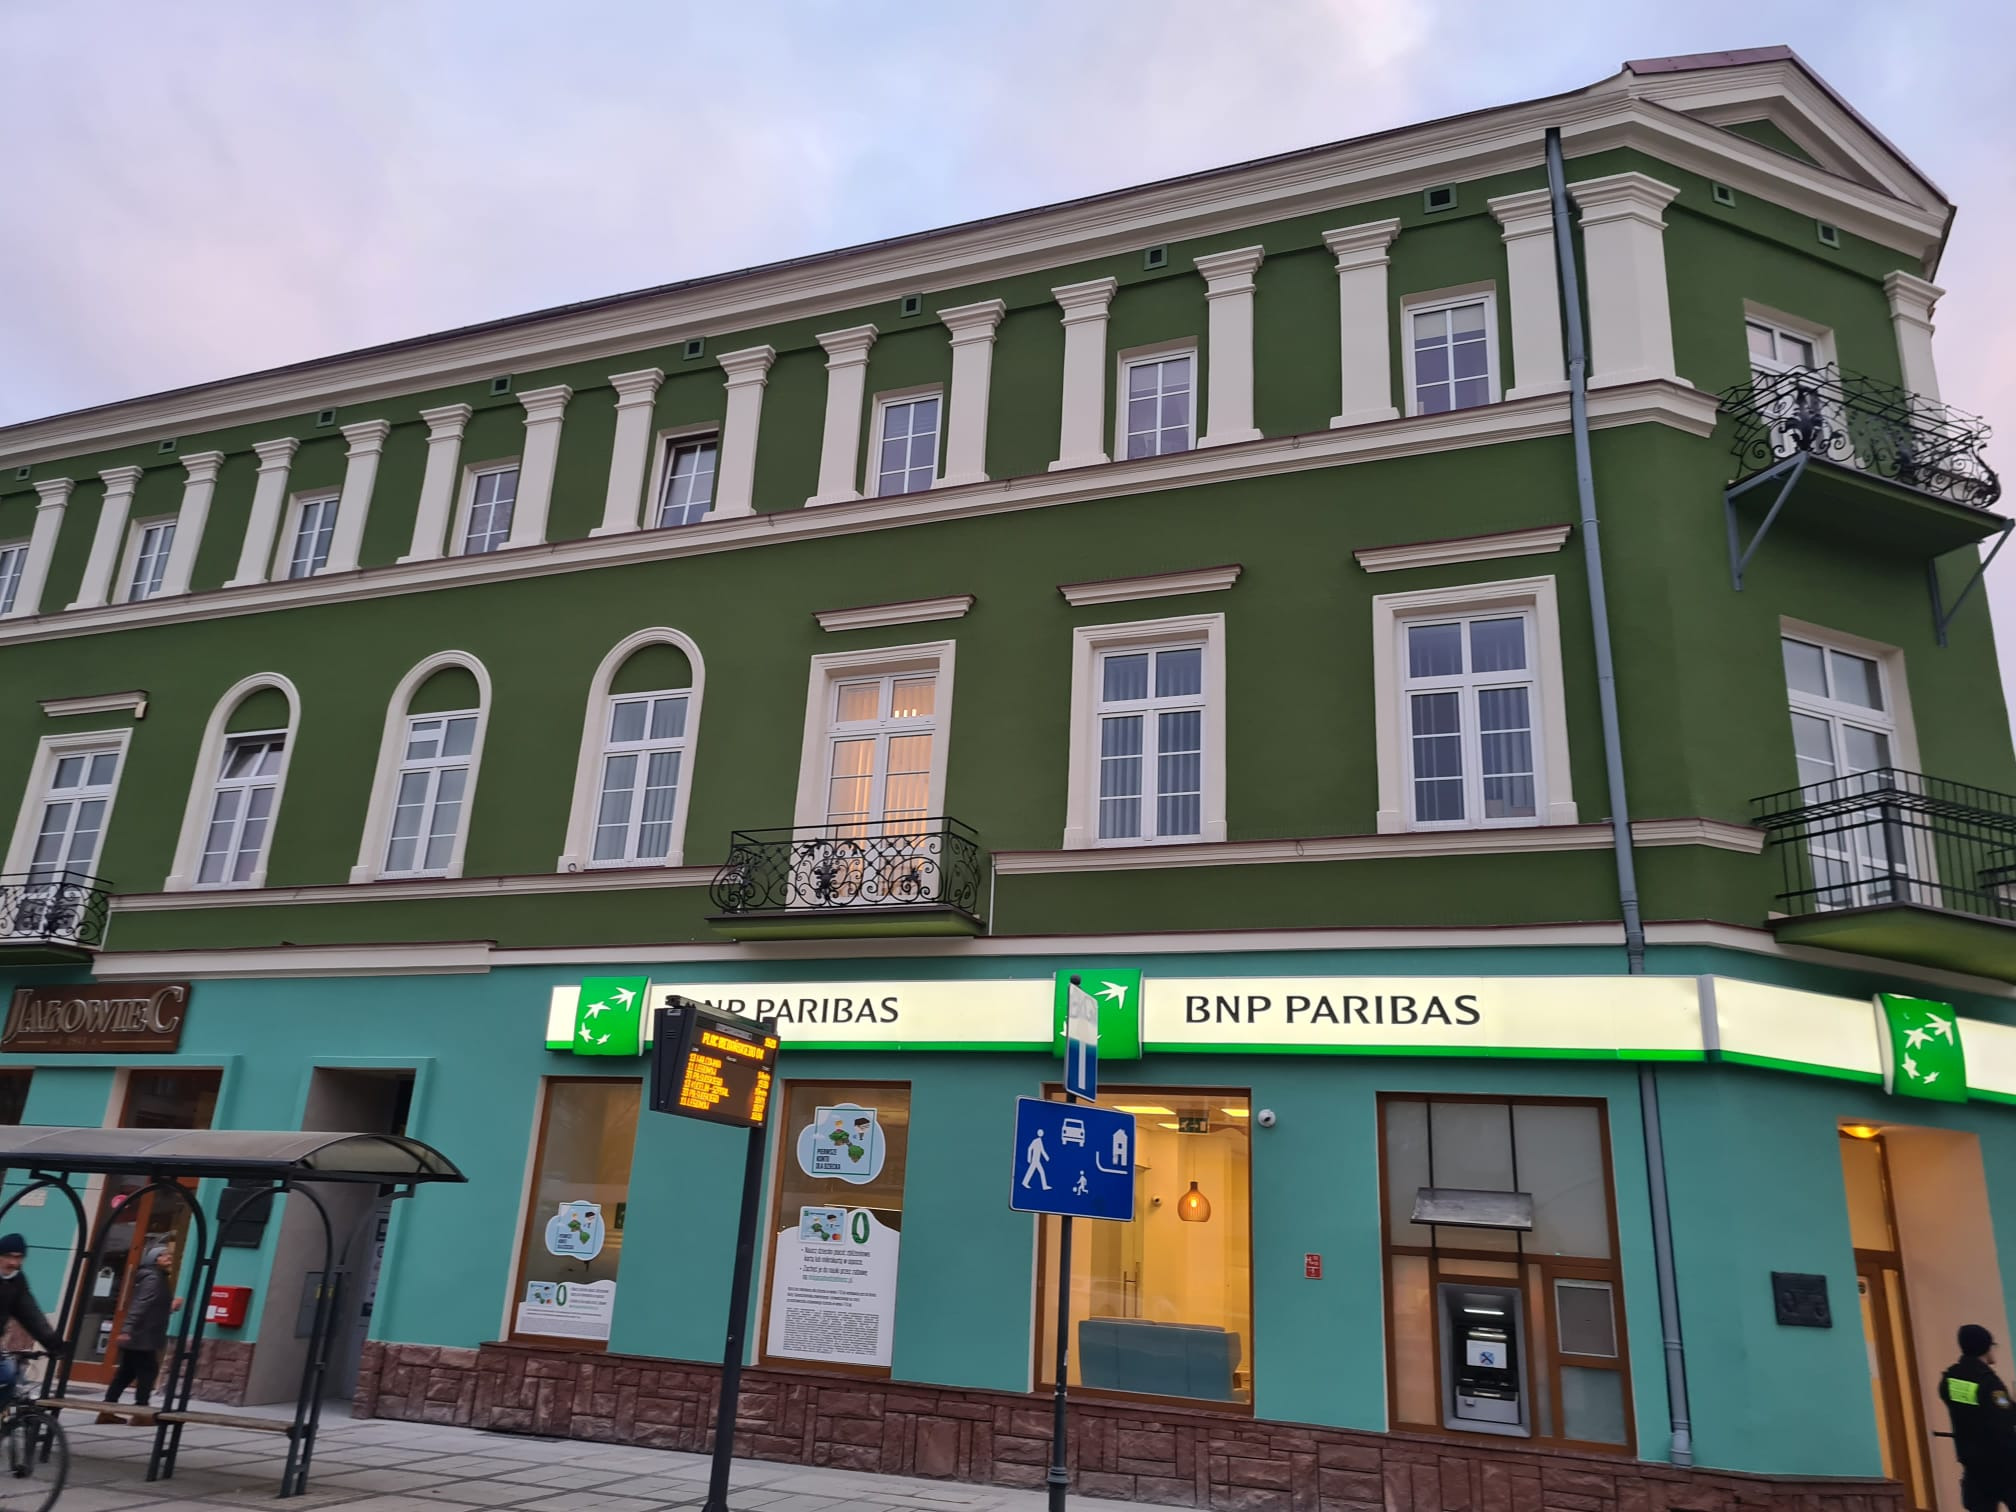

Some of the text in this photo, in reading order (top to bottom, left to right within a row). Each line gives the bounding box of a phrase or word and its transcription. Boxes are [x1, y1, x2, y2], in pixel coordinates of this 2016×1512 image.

[756, 996, 899, 1024] PARIBAS
[1186, 995, 1481, 1025] BNP PARIBAS
